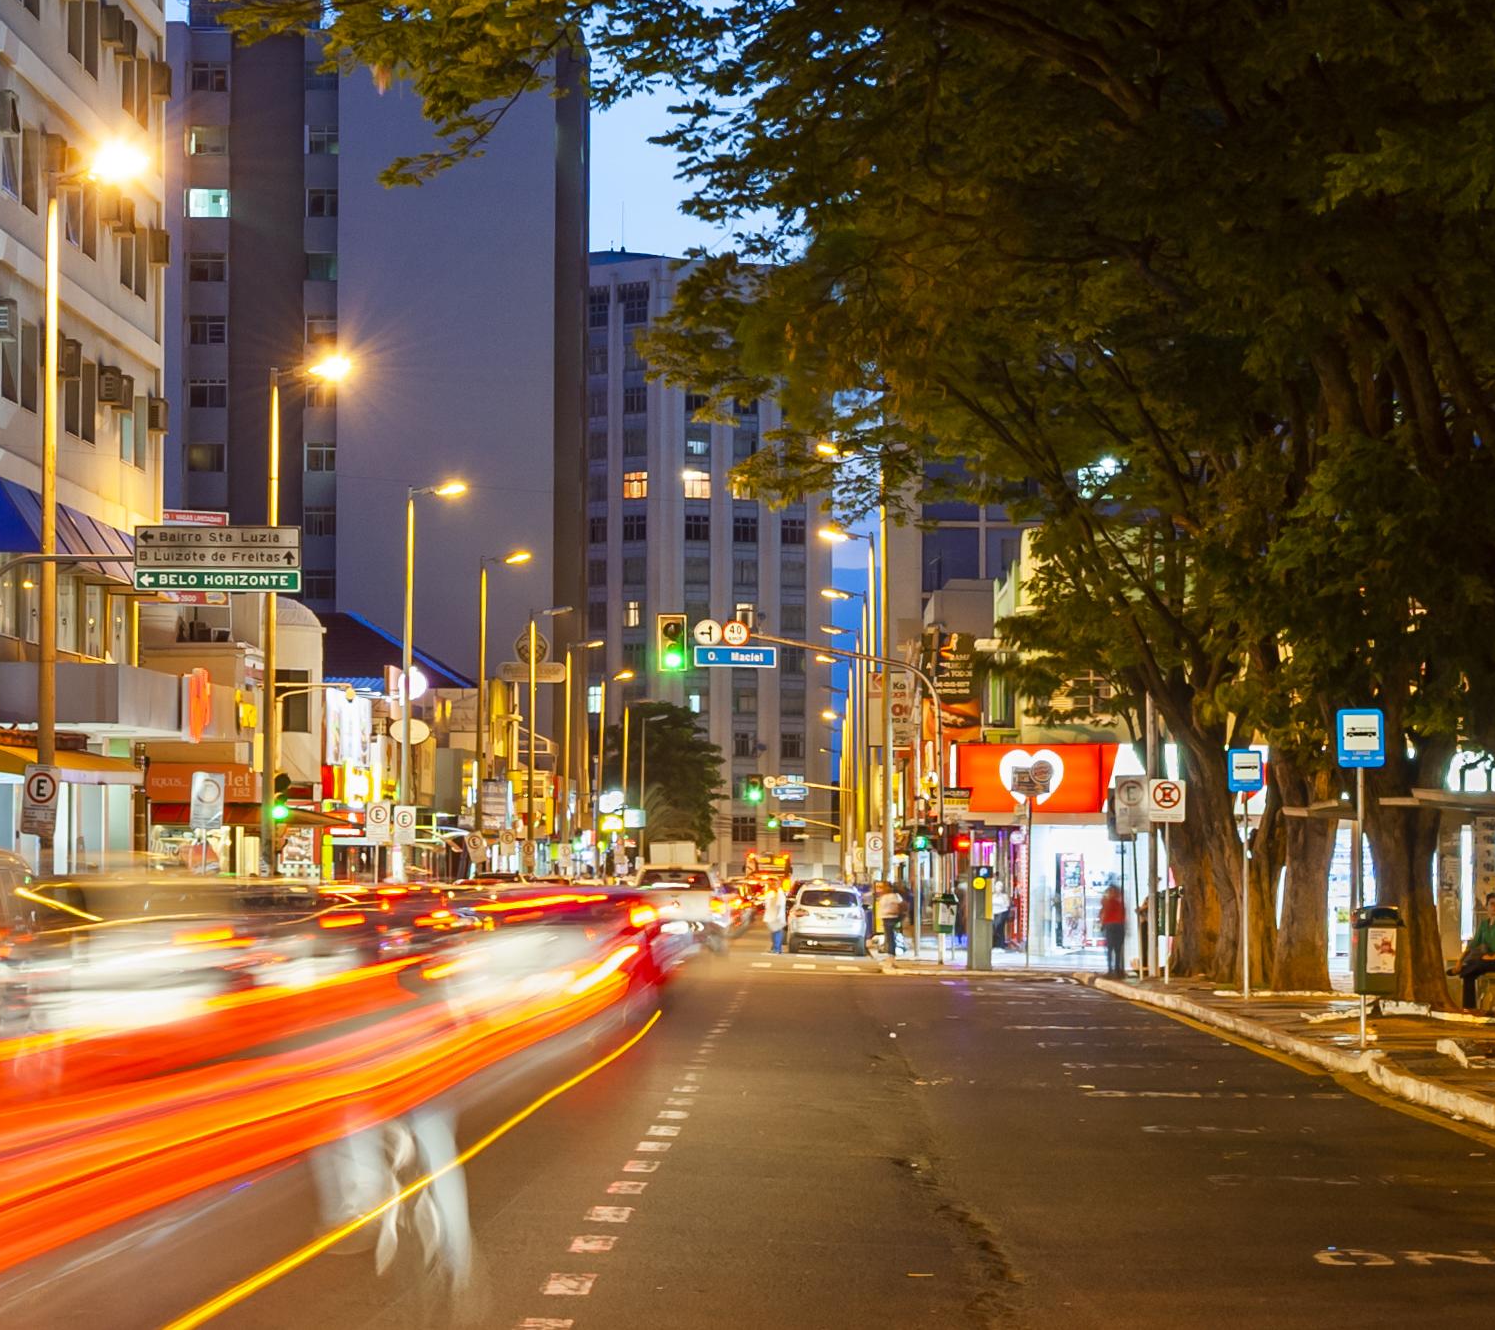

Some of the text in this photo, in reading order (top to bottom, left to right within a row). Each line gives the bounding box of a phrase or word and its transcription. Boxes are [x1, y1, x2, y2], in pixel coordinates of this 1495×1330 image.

[160, 531, 280, 543] Bairro Sta Luzia
[139, 551, 281, 562] B Luizote de Freitas
[159, 573, 288, 586] BELO HORIZONTE
[729, 625, 742, 635] 40
[731, 651, 764, 662] Maciel
[36, 778, 48, 798] E
[1126, 785, 1136, 802] E
[375, 809, 381, 819] E
[401, 814, 408, 825] E
